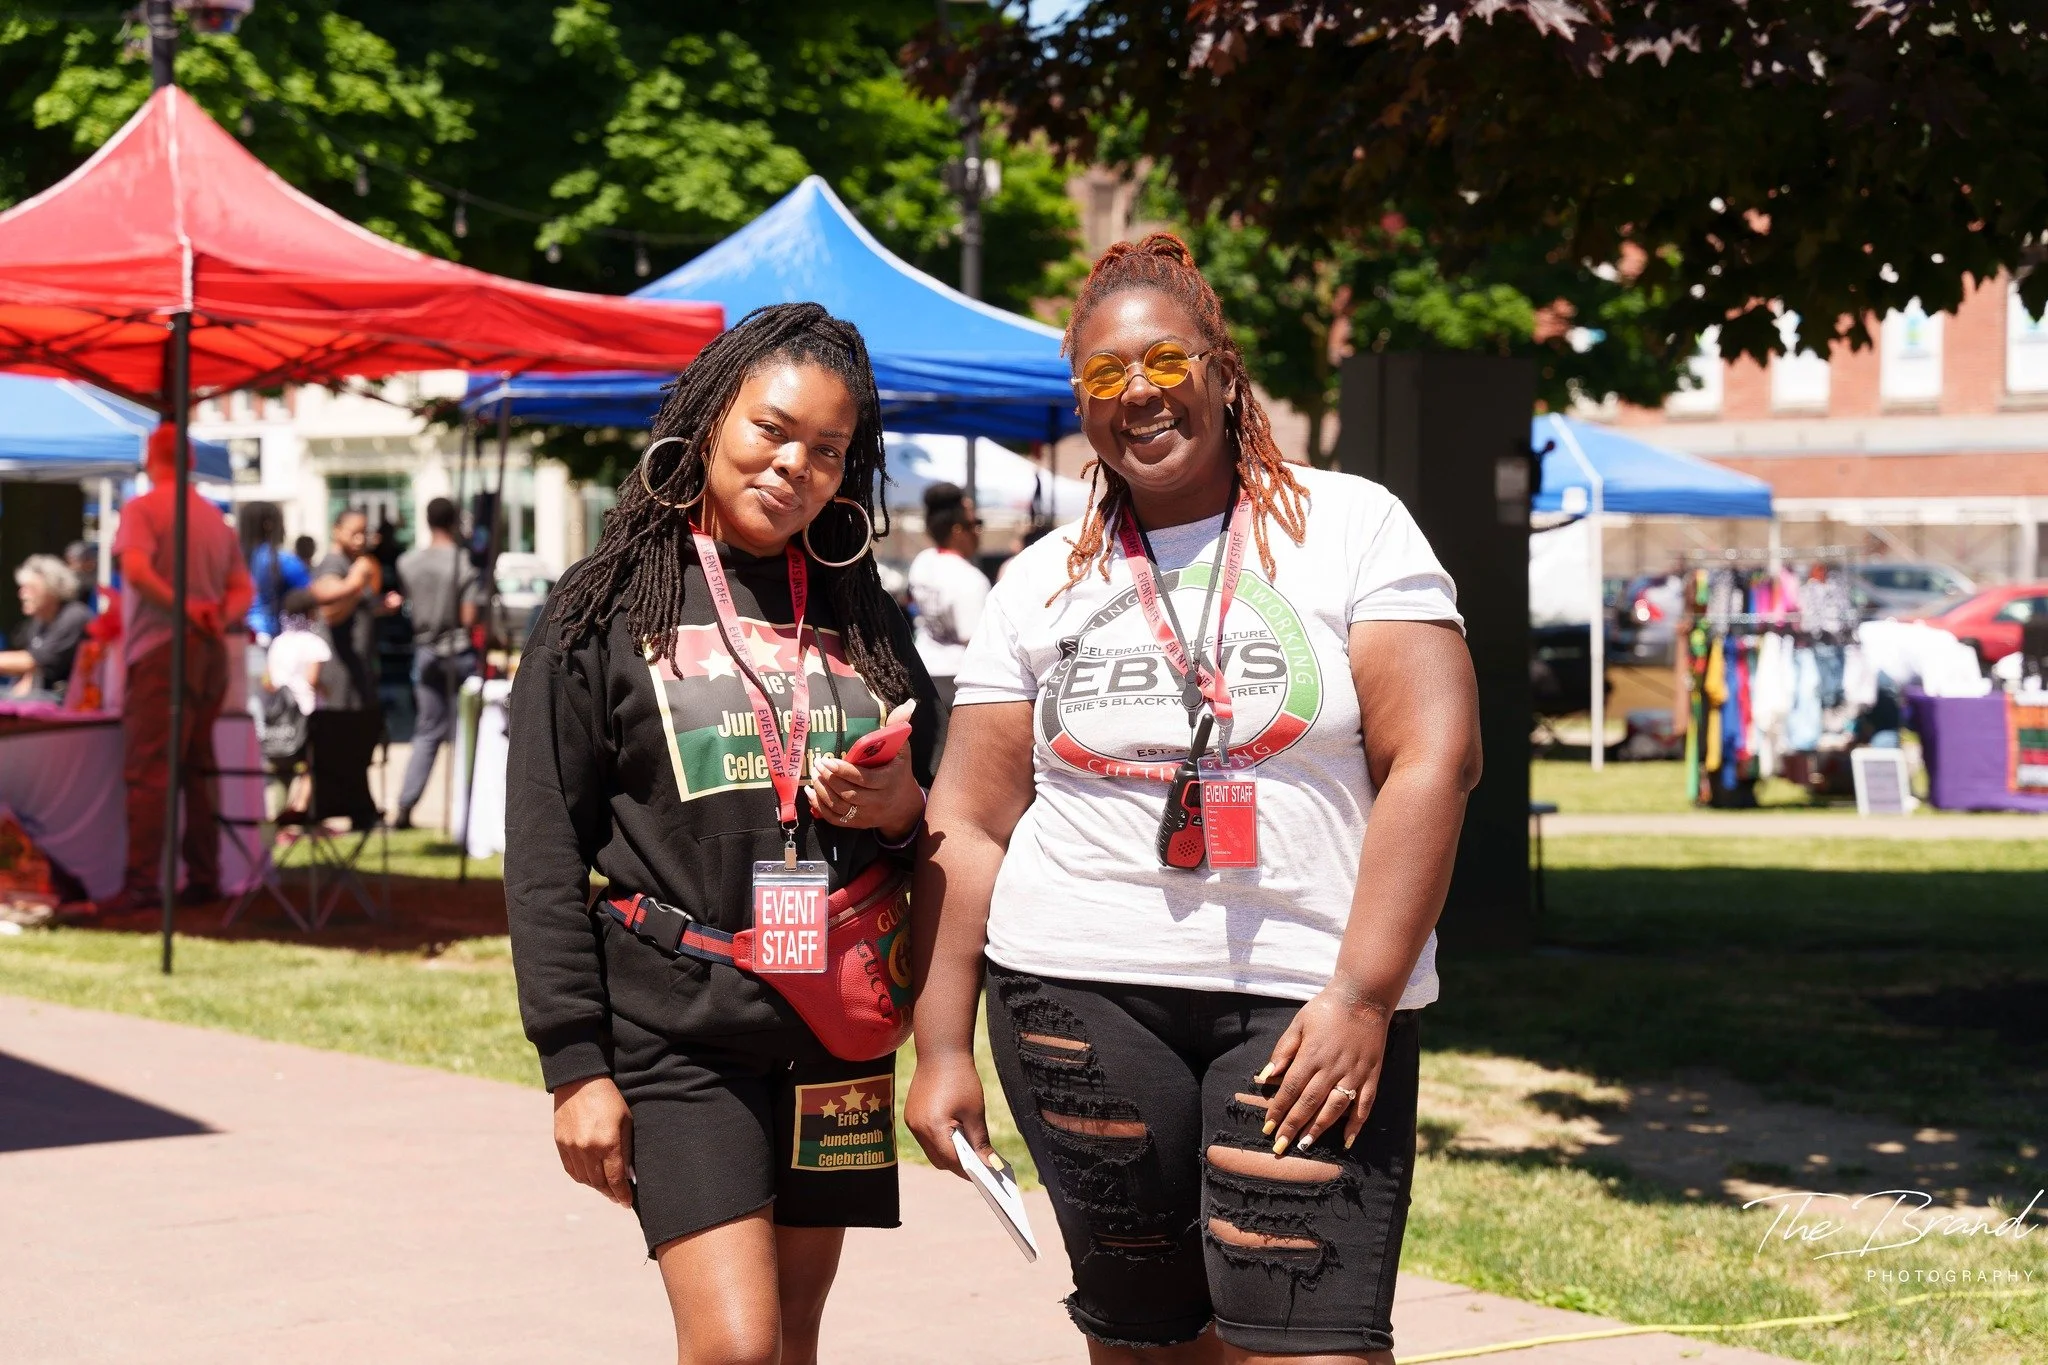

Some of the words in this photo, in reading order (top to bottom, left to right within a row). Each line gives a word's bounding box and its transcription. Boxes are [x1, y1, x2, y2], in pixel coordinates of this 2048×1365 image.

[1231, 532, 1244, 558] STAFF
[701, 543, 719, 572] EVENT
[711, 573, 730, 605] STAFF
[1137, 571, 1152, 598] EVENT
[1225, 560, 1238, 590] EVENT
[1144, 597, 1160, 622] STAFF
[1241, 577, 1314, 685] TWORKING
[1045, 593, 1139, 699] PROMTING
[1081, 644, 1162, 656] CELEBRATIN
[1065, 699, 1108, 713] ERIE'S
[1111, 697, 1167, 706] BLACK
[1229, 685, 1279, 698] TREET
[794, 708, 806, 742] STAFF
[758, 709, 776, 743] EVENT
[768, 745, 785, 778] STAFF
[1137, 748, 1171, 757] EST.
[788, 742, 801, 777] EVENT
[1205, 785, 1229, 803] EVENT
[1231, 785, 1253, 803] STAFF
[762, 890, 819, 925] EVENT
[762, 930, 819, 965] STAFF
[838, 1111, 869, 1127] Erie's
[820, 1129, 884, 1147] Juneteenth
[818, 1150, 885, 1167] Celebration
